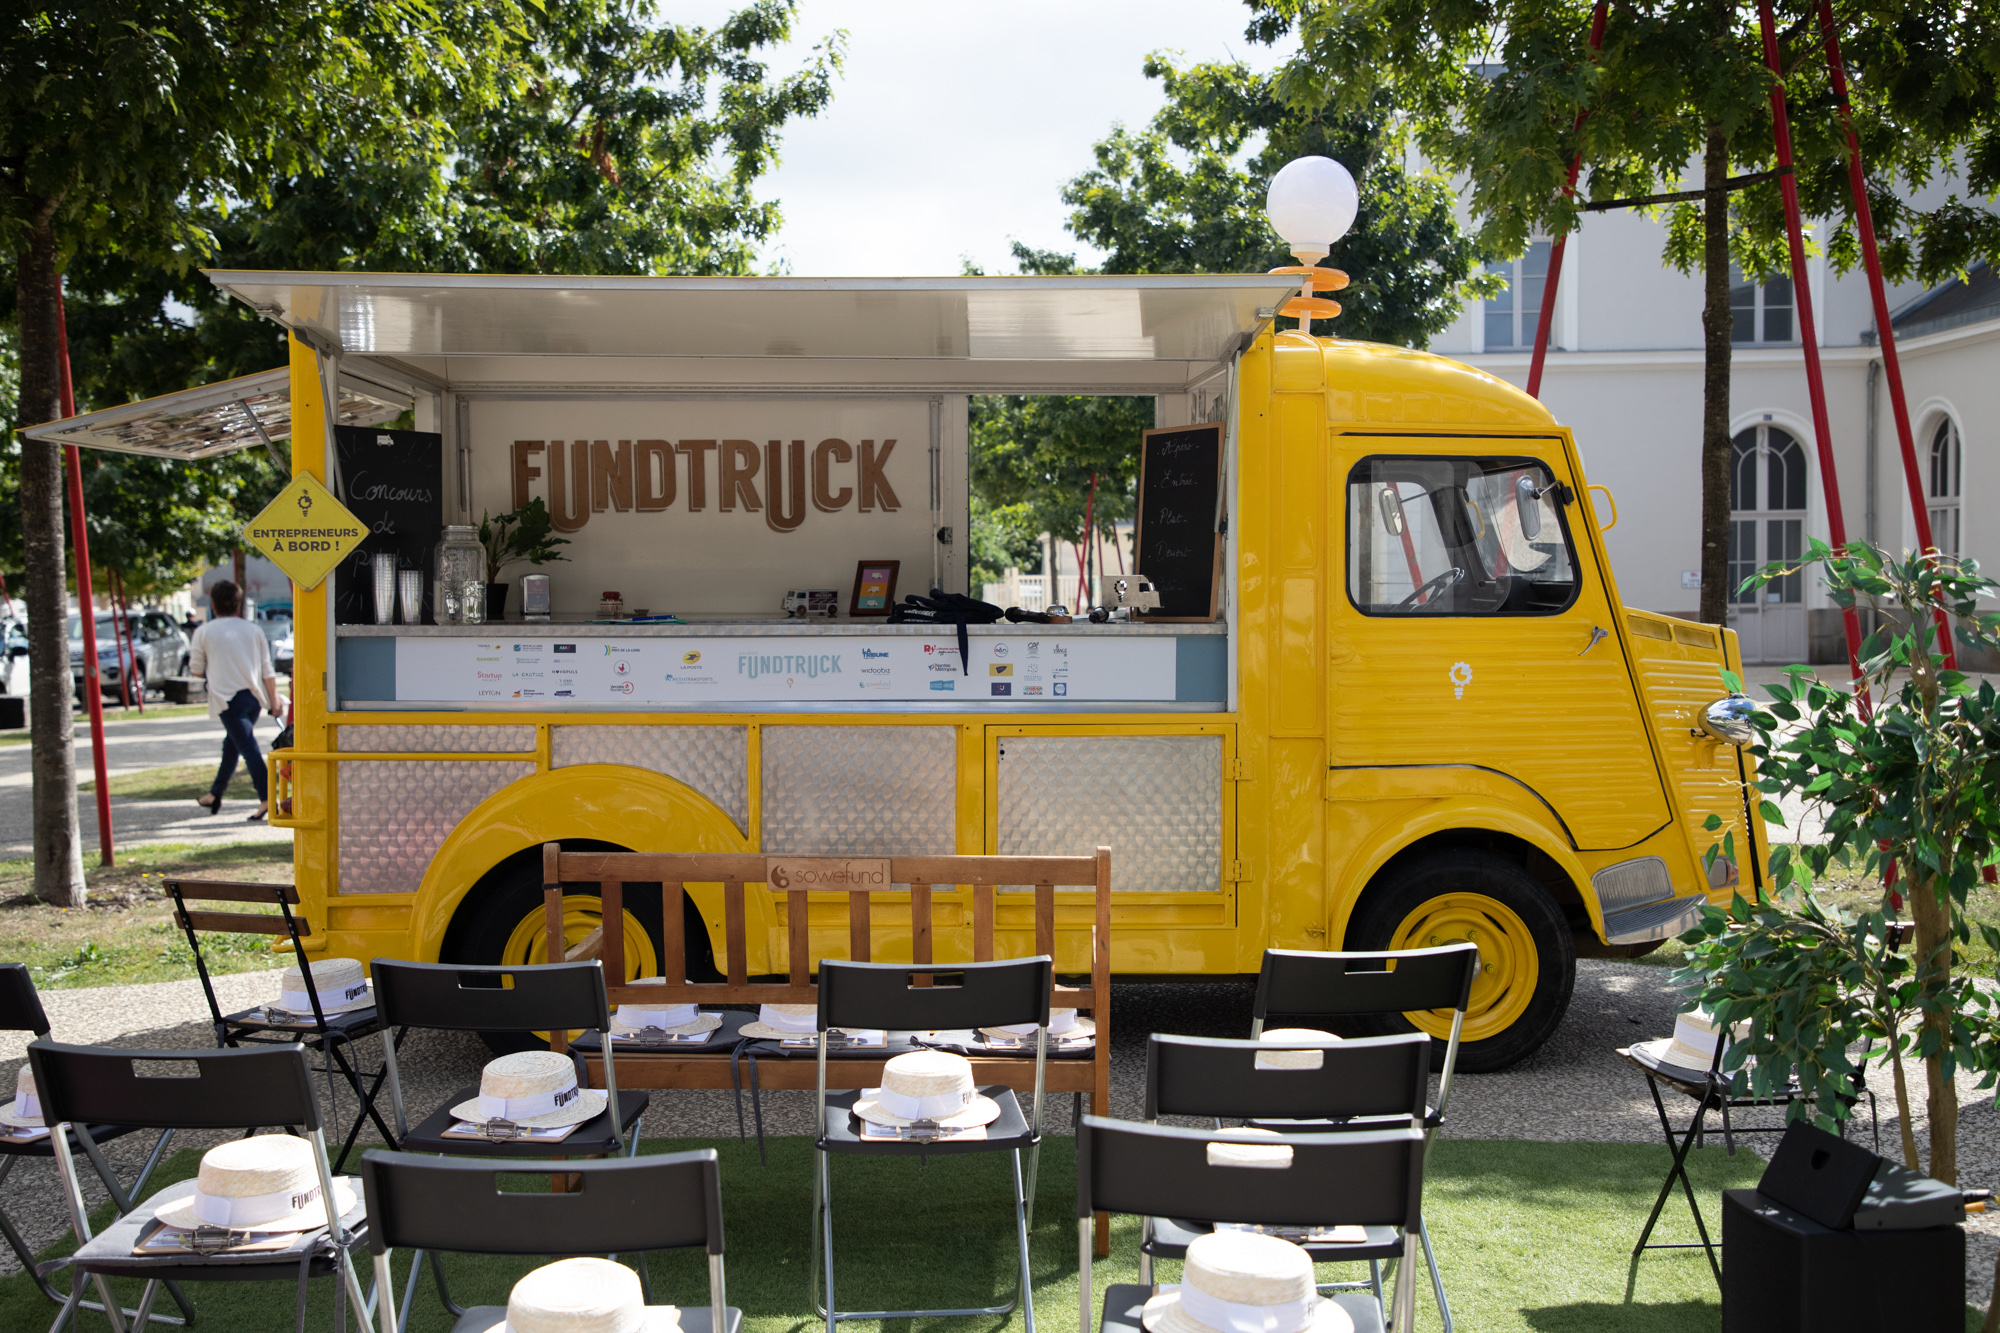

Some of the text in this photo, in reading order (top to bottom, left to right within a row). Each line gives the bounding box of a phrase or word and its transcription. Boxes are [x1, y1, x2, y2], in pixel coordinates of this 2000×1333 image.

[350, 470, 433, 503] Concours
[510, 438, 902, 534] FUNDTRUCK
[253, 528, 359, 538] ENTREPRENEURS
[373, 510, 396, 535] de
[273, 539, 284, 552] À
[288, 541, 331, 552] BORD
[477, 671, 502, 681] Startup
[738, 654, 842, 679] FUNDTRUCK
[795, 861, 884, 885] sowefund
